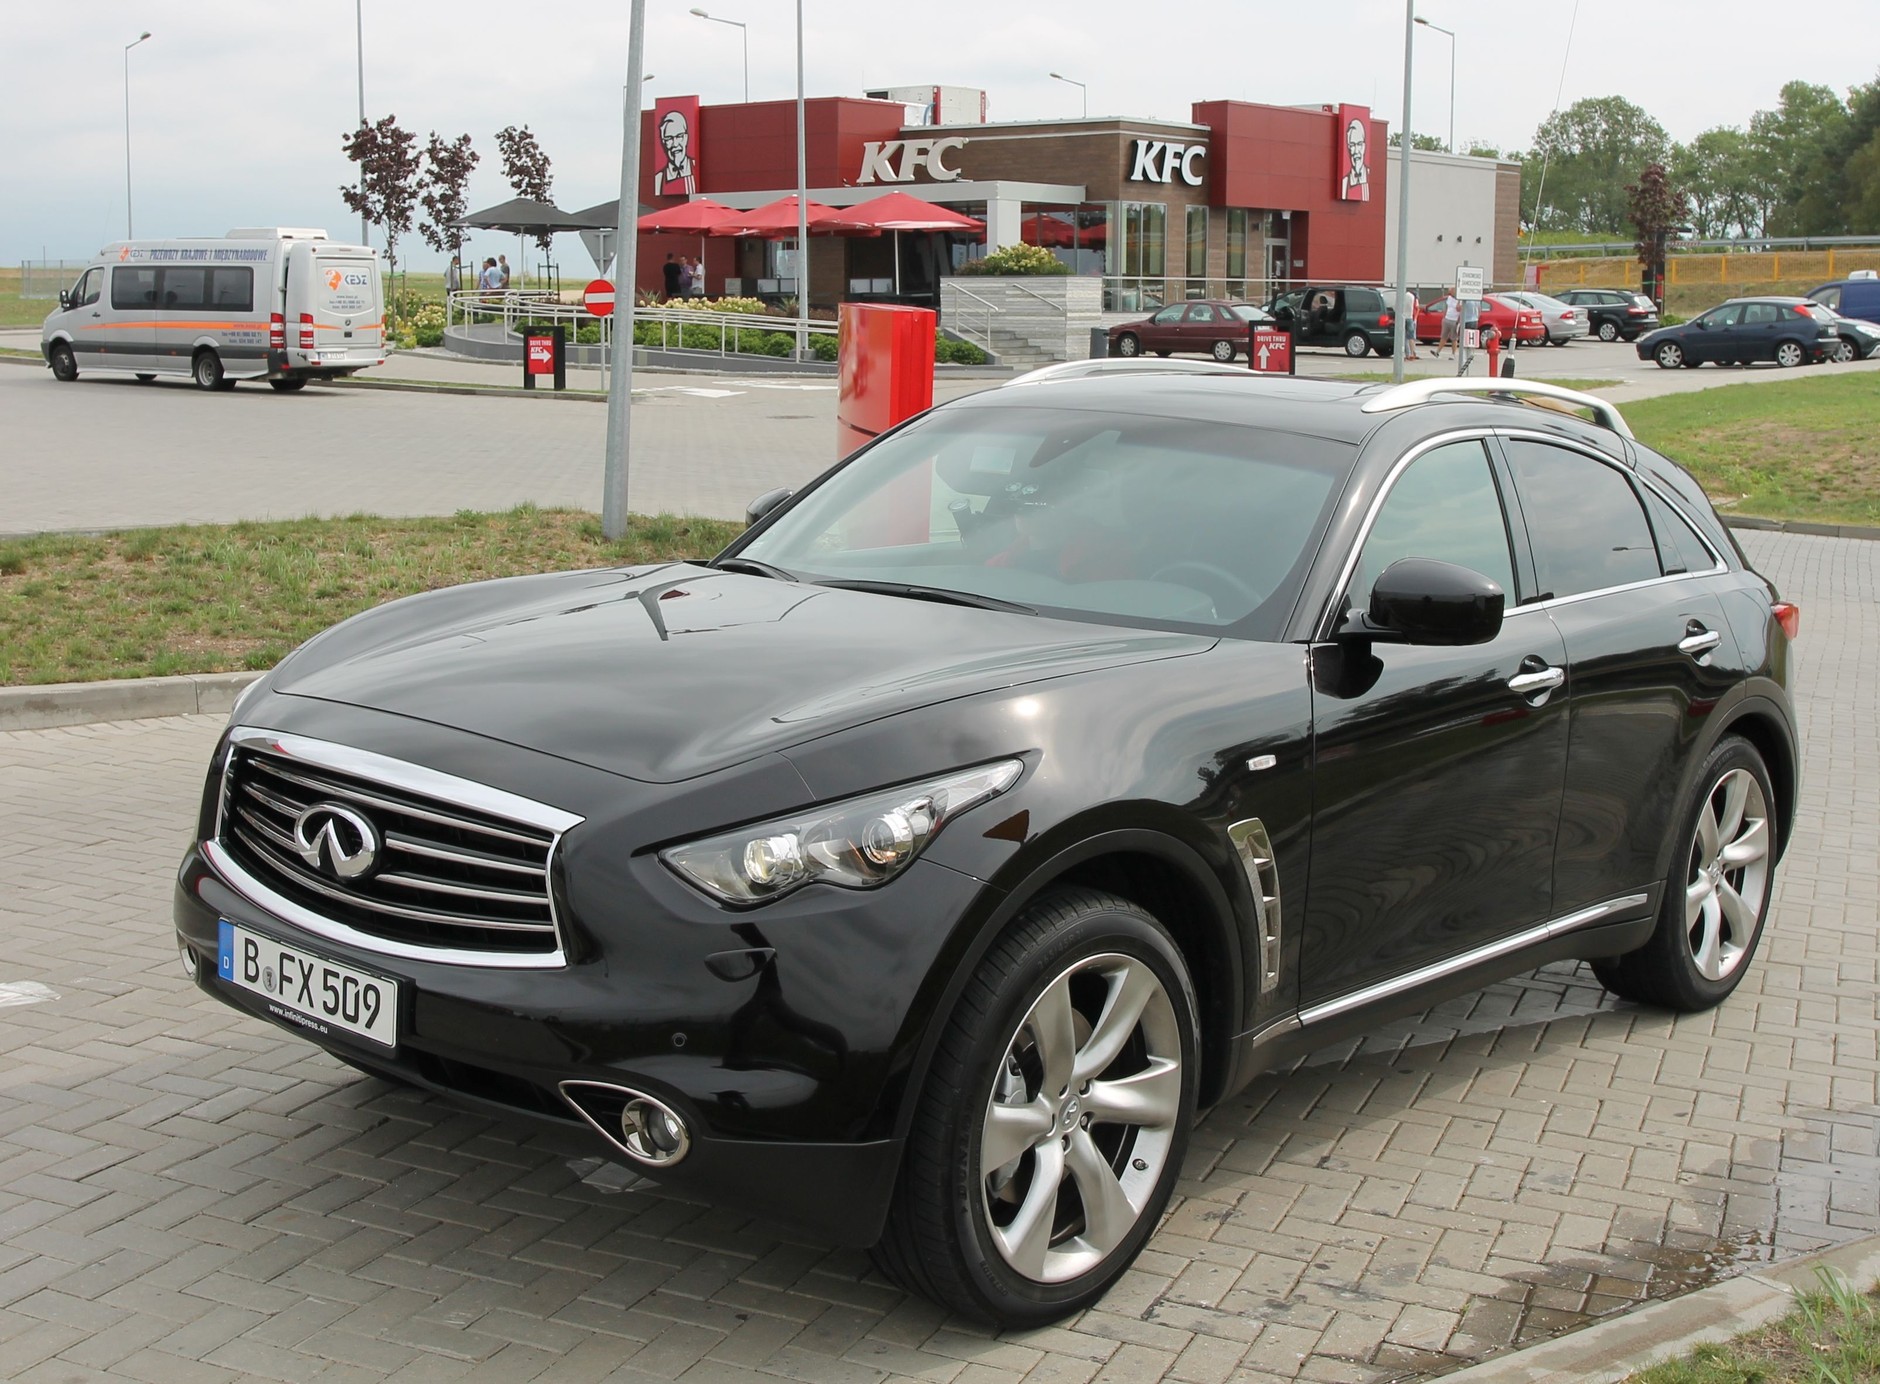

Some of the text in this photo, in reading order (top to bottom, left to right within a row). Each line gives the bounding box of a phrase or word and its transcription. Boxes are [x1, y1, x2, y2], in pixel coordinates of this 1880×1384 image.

[857, 137, 969, 185] KFC
[1130, 139, 1206, 187] KFC
[1468, 330, 1475, 346] H
[223, 956, 229, 969] D
[244, 938, 381, 1030] B FX 509
[268, 1003, 329, 1035] www.infinitipress.eu
